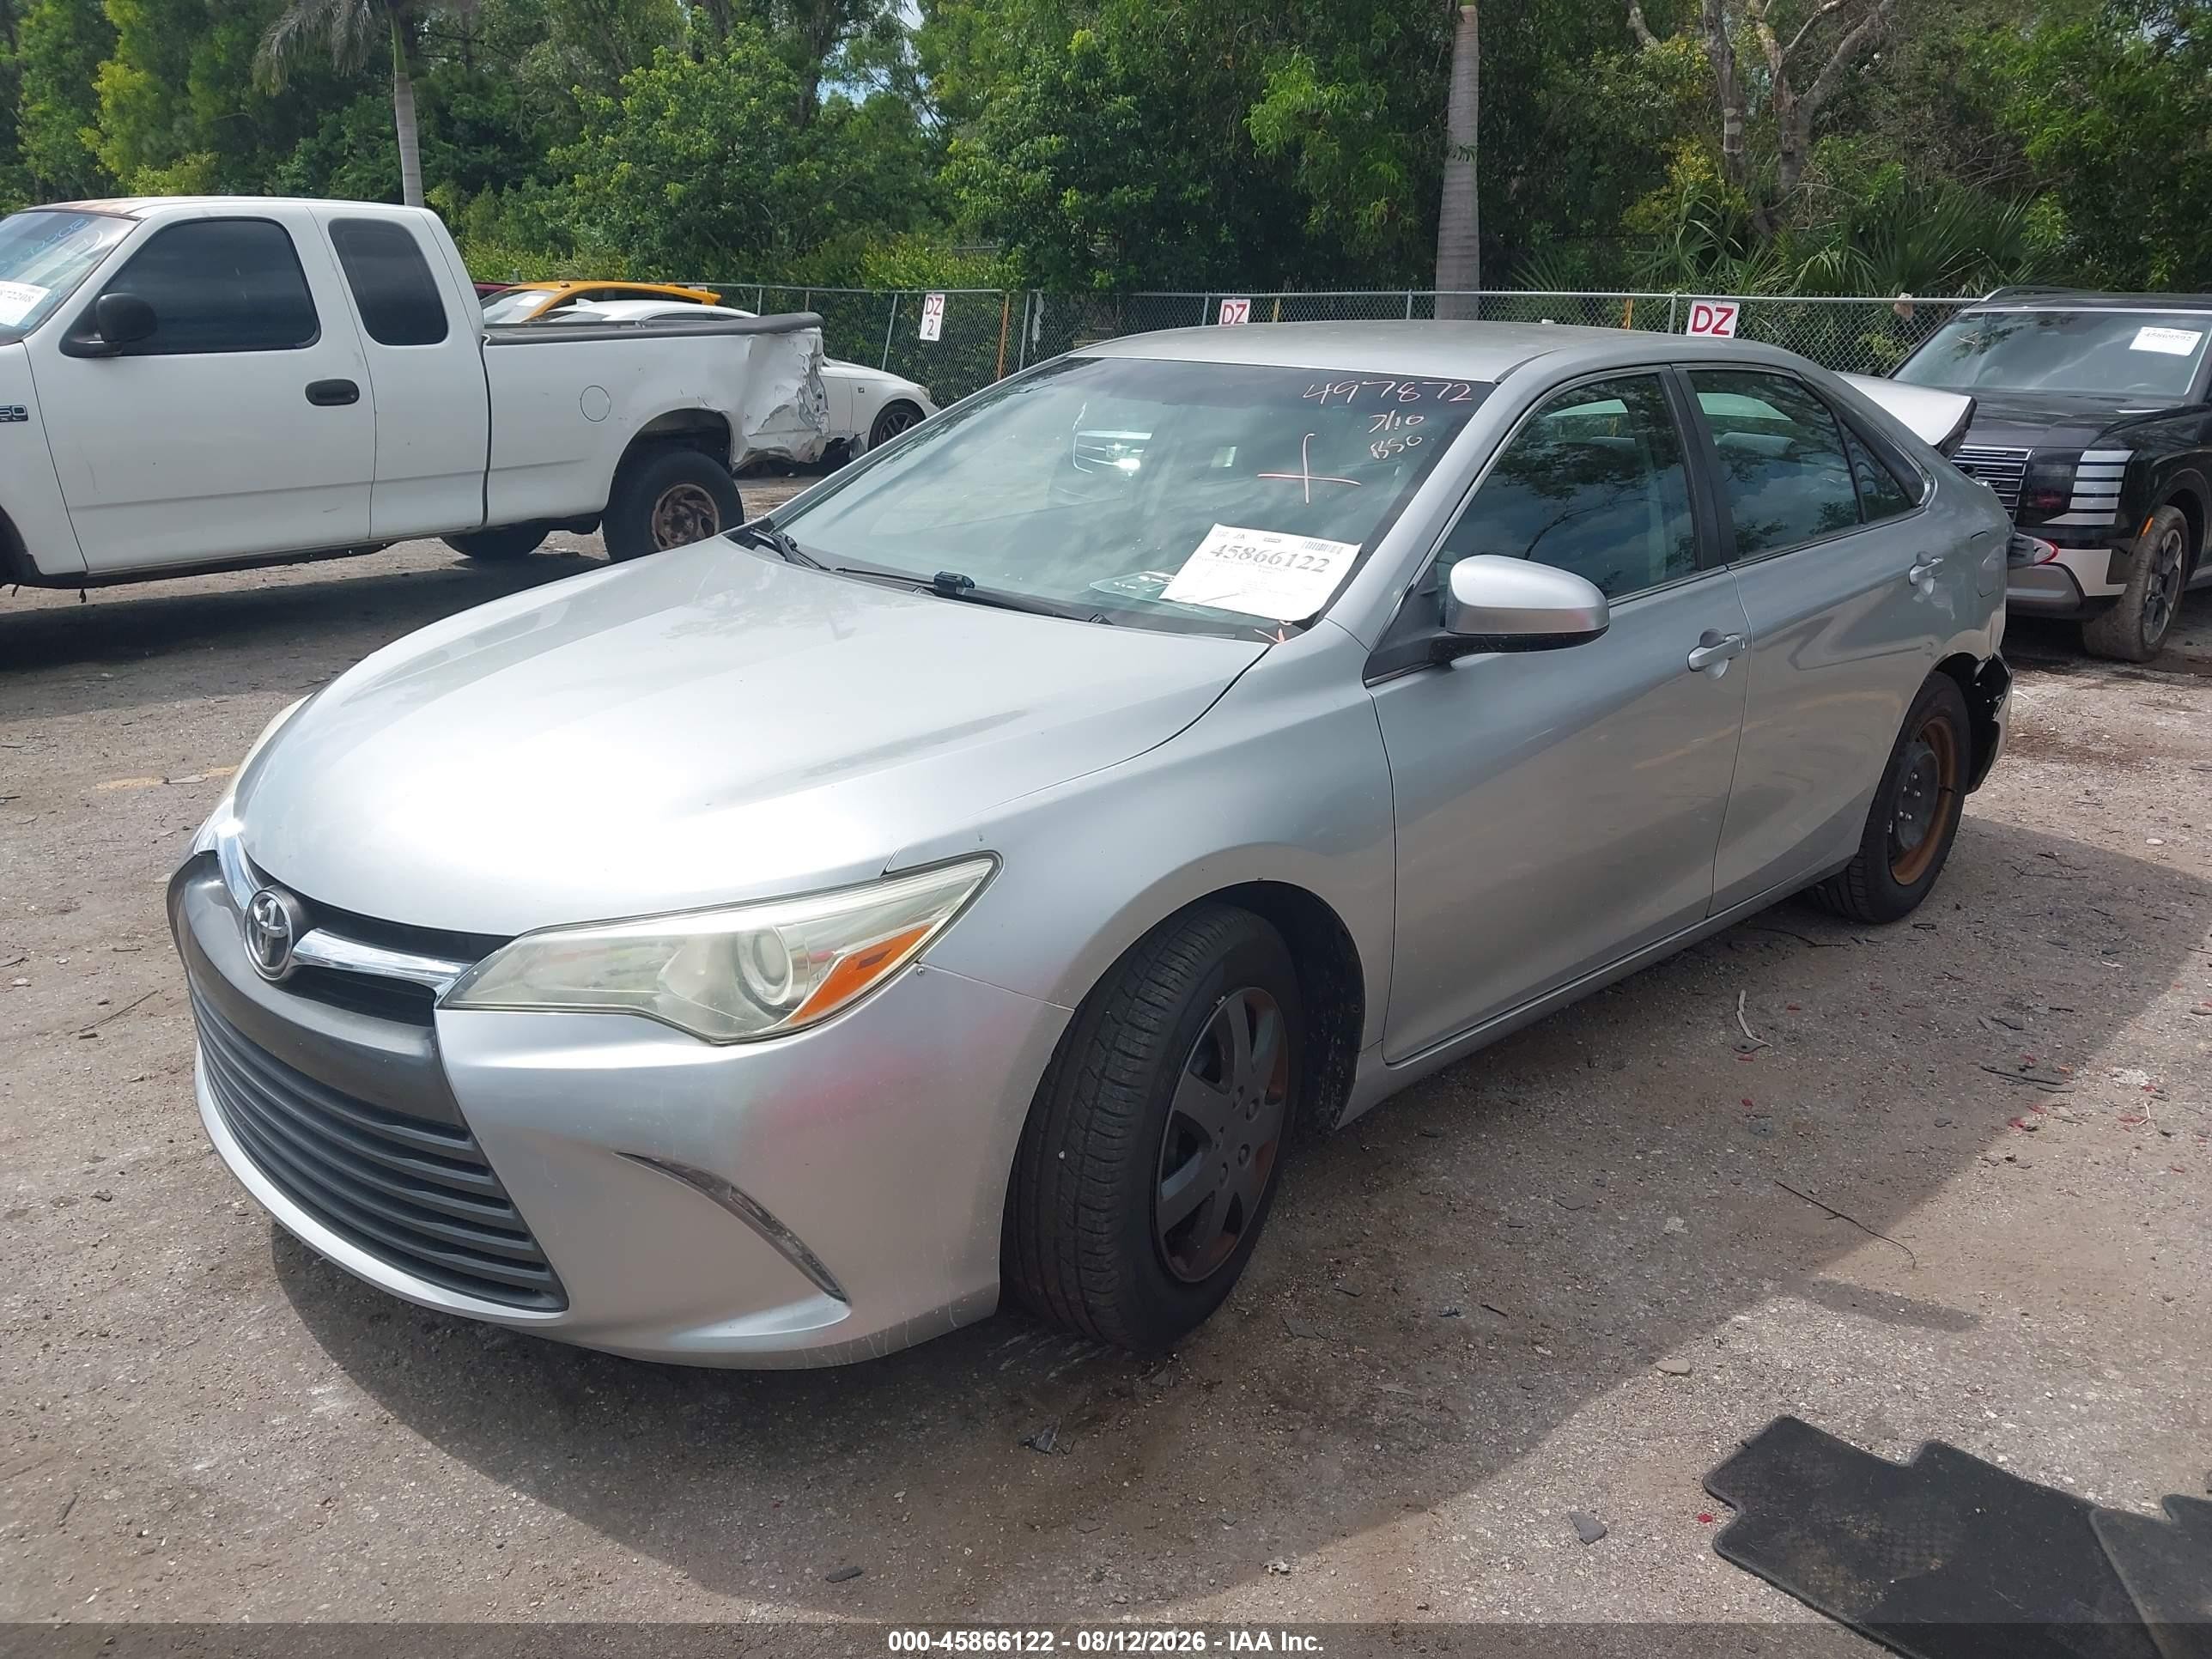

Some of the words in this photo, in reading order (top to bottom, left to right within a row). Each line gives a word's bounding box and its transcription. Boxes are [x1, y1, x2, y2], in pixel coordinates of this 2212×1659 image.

[925, 296, 943, 316] DZ
[1221, 303, 1248, 325] DZ
[927, 318, 934, 336] 2
[1691, 305, 1735, 336] DZ
[1302, 380, 1474, 405] 497872
[1210, 544, 1331, 573] 45866122
